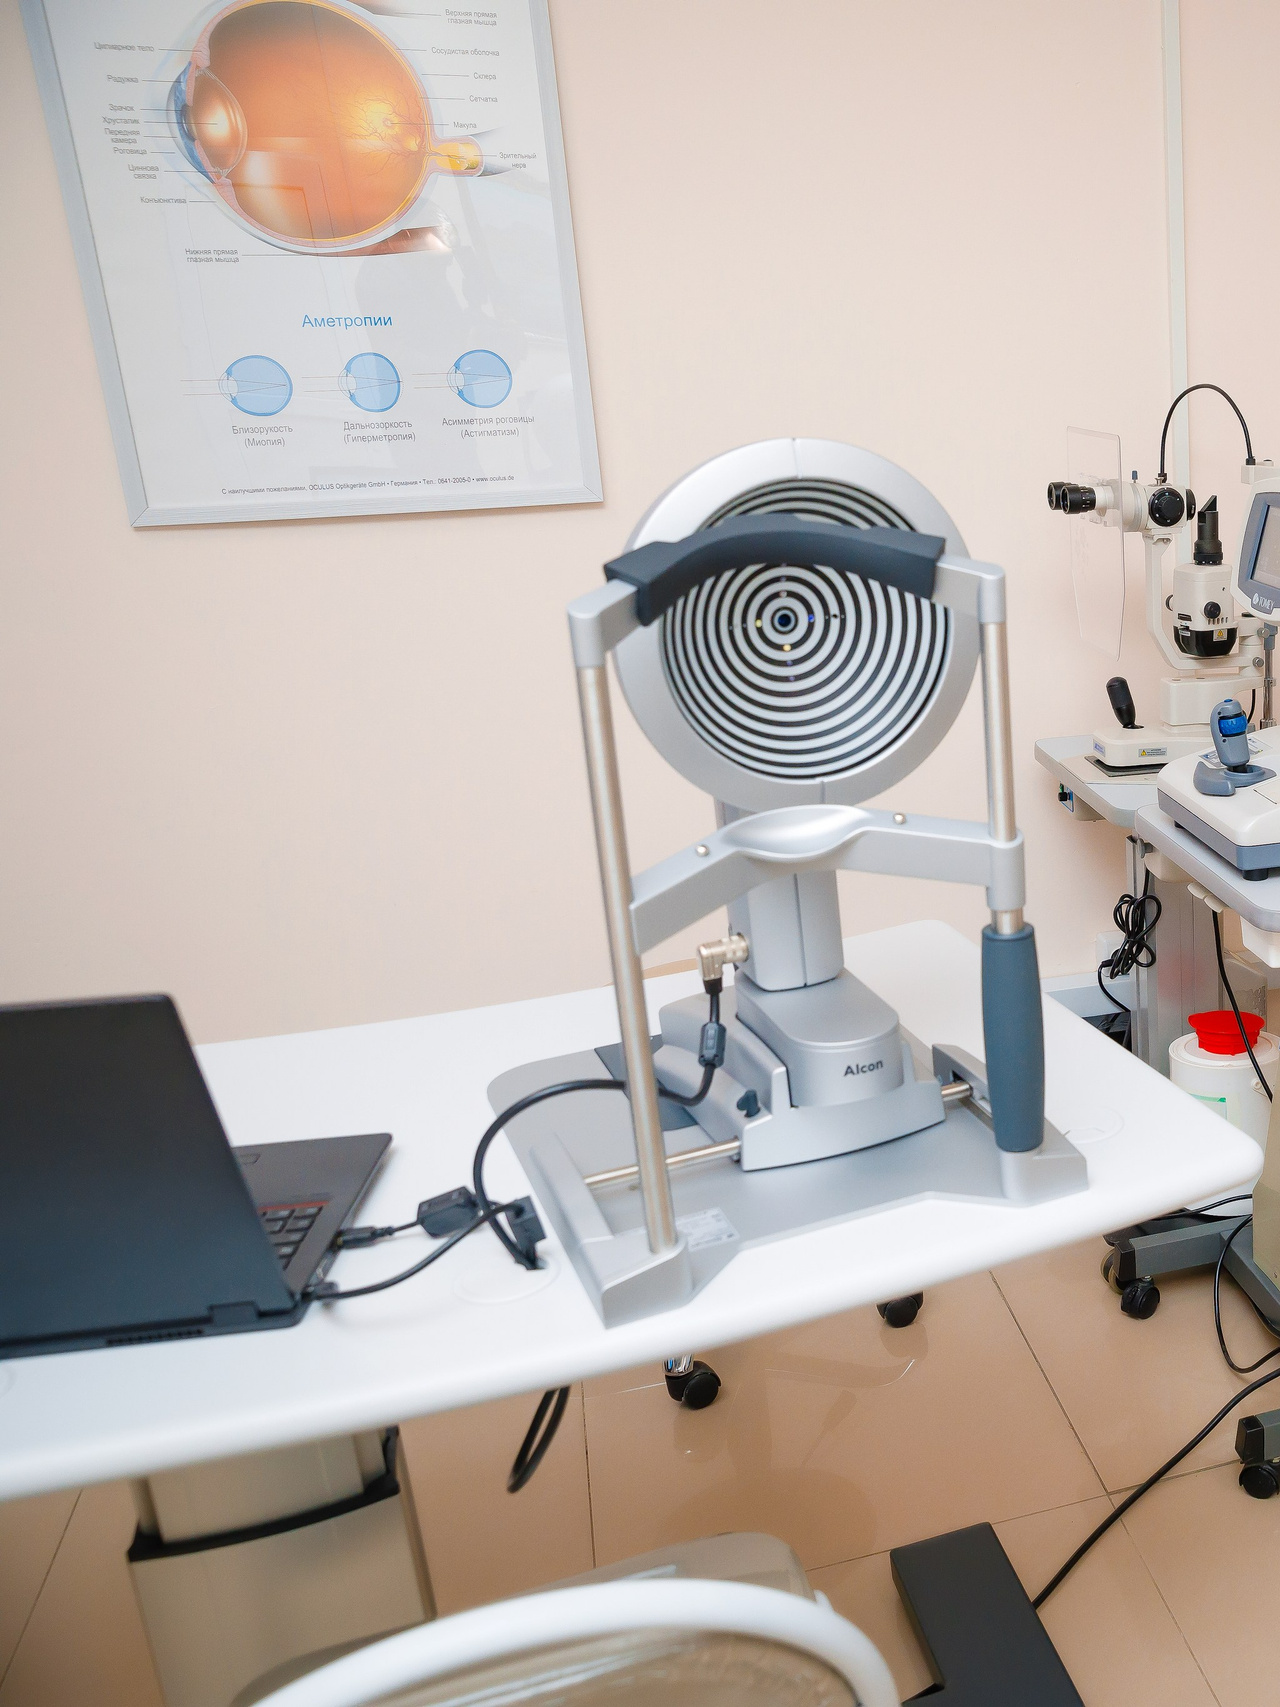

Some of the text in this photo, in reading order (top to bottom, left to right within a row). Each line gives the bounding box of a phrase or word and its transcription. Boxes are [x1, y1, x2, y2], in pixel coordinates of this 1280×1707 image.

[445, 8, 472, 17] Верхняя
[431, 46, 500, 56] Сосудистая оболочка
[106, 74, 138, 84] Радужка
[469, 94, 498, 102] Сетчатка
[108, 104, 136, 112] Зрачок
[102, 116, 140, 125] Хрусталик
[104, 128, 140, 136] Передняя
[113, 146, 148, 155] Роговица
[499, 152, 537, 160] Зрительный
[302, 314, 392, 330] Аметропии
[344, 420, 412, 432] Дальнозоркость
[442, 416, 535, 428] Асимметрия роговицы
[232, 424, 294, 436] Близорукость
[460, 428, 520, 439] (Астигматизм)
[244, 437, 286, 448] (Миопия)
[344, 432, 416, 444] (Гиперметропия)
[1259, 596, 1275, 610] TOMEY
[844, 1060, 883, 1076] Alcon
